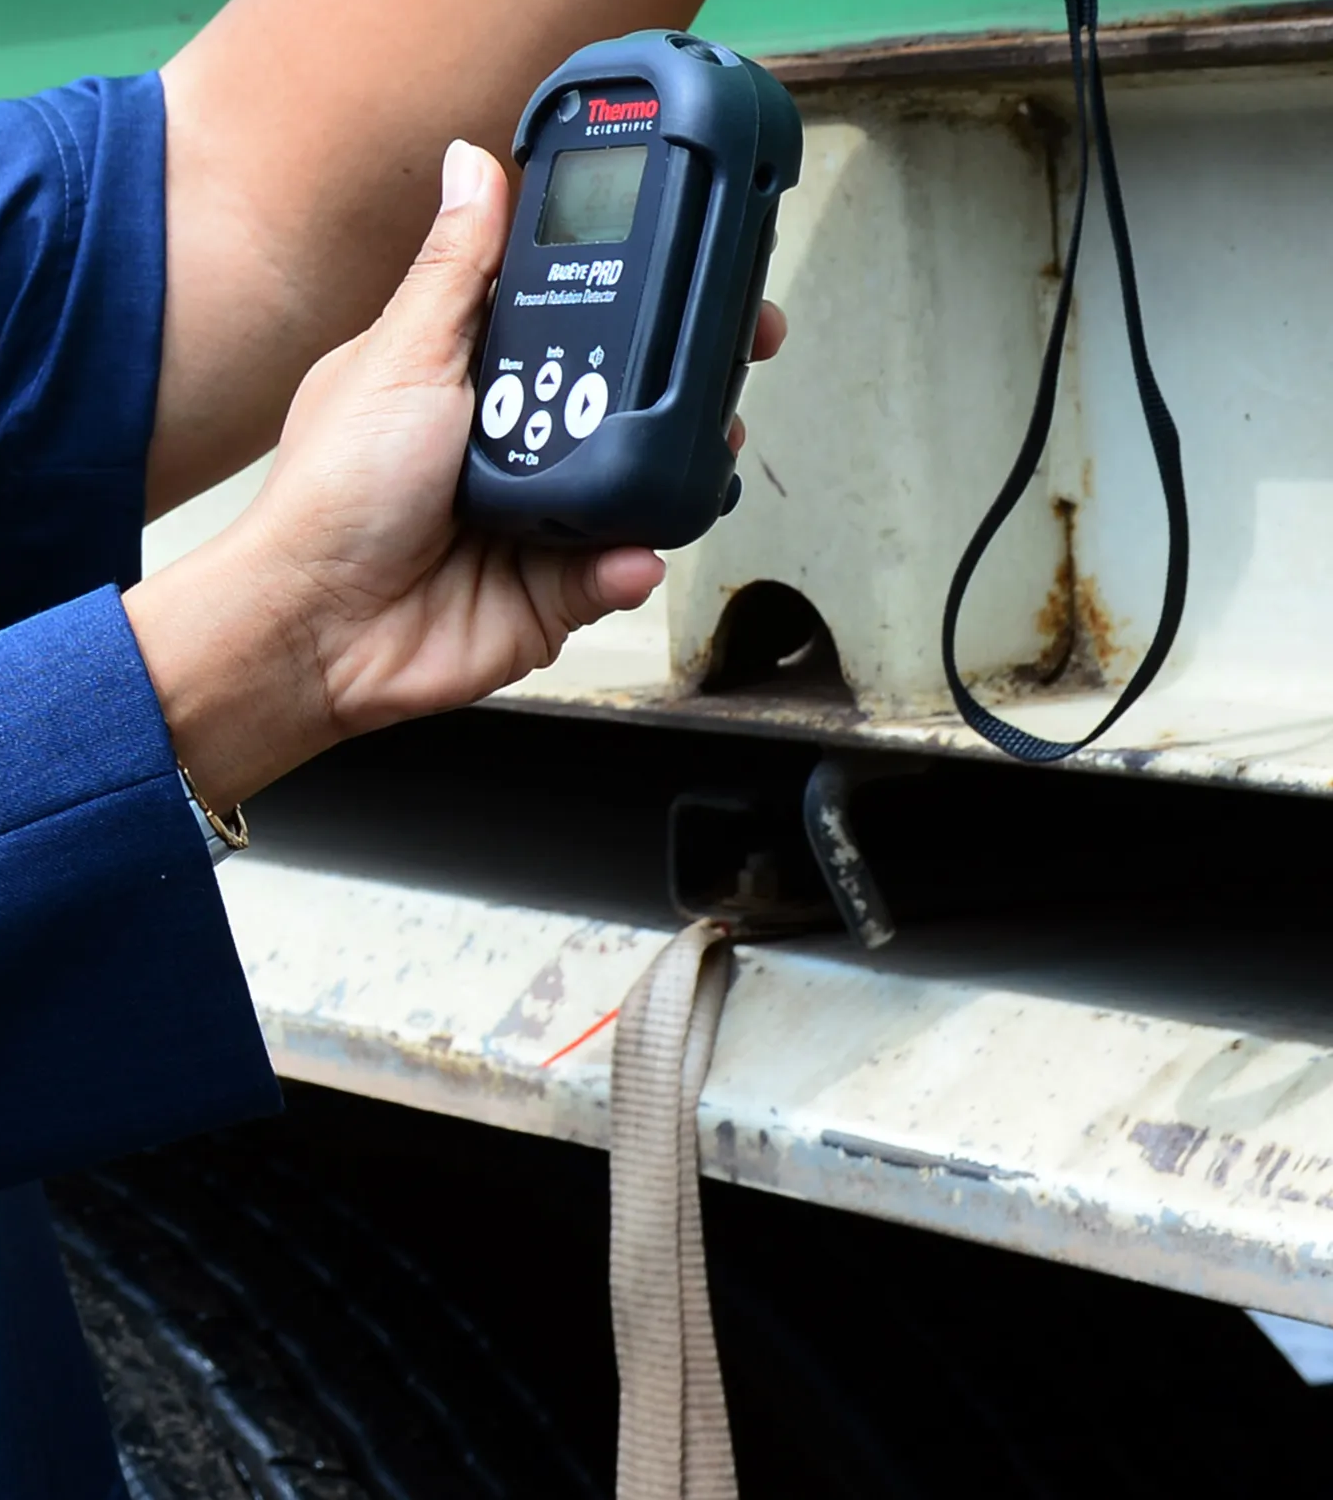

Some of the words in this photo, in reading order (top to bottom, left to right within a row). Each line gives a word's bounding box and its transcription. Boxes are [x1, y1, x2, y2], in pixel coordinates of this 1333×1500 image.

[588, 99, 659, 123] Thermo
[585, 120, 653, 136] SCIENTIFIC
[586, 259, 624, 287] PRD
[514, 291, 549, 306] Personal
[547, 289, 583, 305] Radiation
[582, 288, 617, 304] Detector
[546, 346, 564, 358] Info
